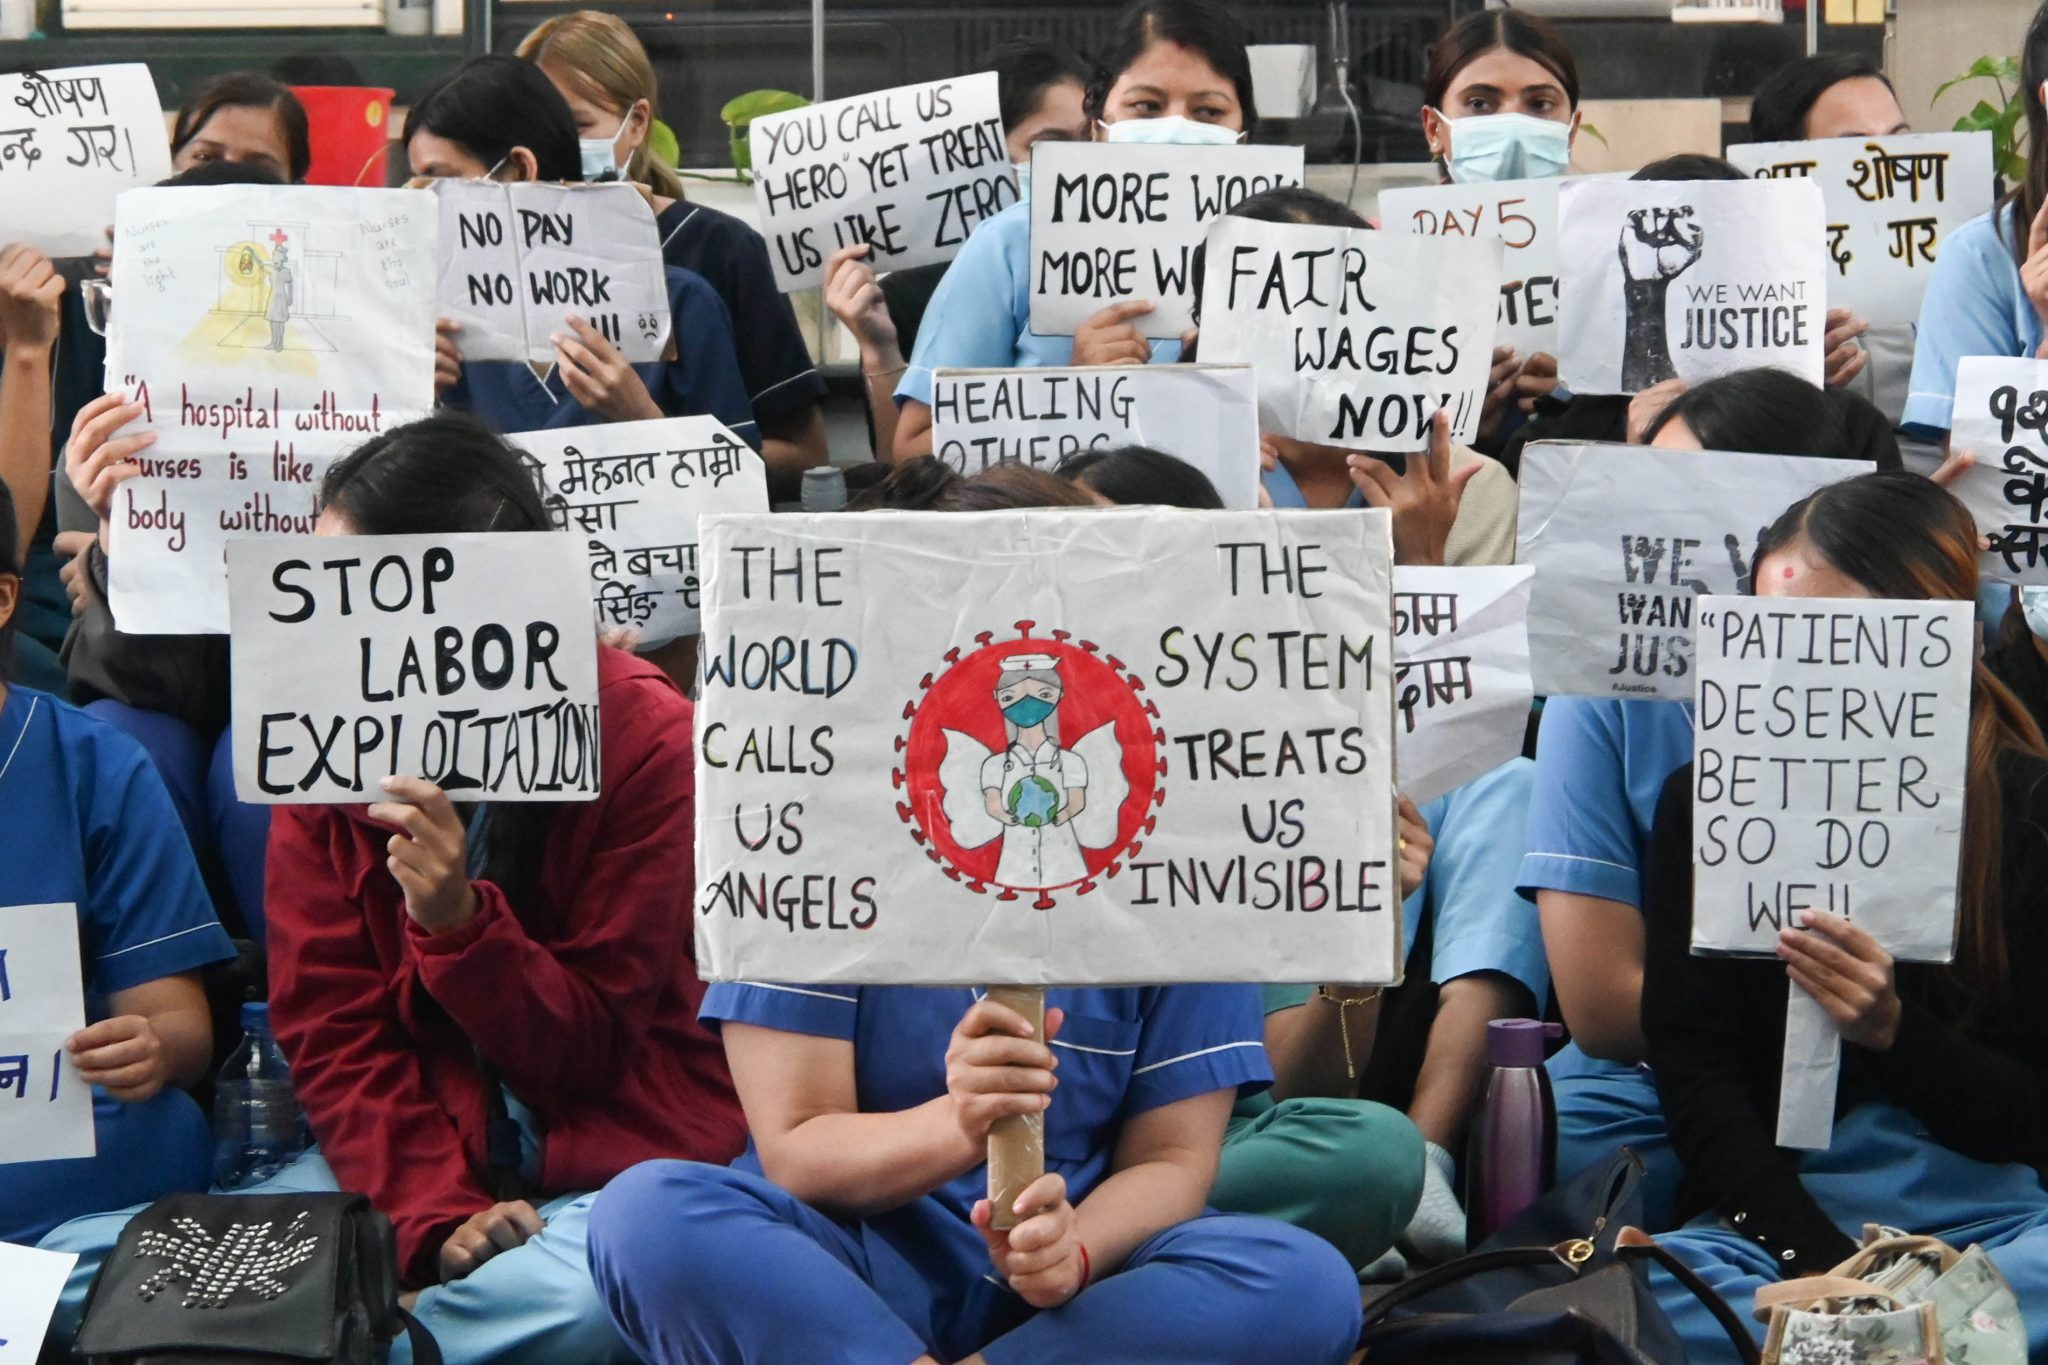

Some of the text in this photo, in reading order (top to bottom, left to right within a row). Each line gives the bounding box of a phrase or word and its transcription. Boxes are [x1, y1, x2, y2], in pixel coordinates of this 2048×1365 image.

[762, 84, 953, 165] YOU CALL US
[858, 143, 910, 193] YET
[919, 118, 1005, 175] TREAT
[1846, 142, 1949, 203] शोषण
[1051, 172, 1170, 224] MORE
[1412, 198, 1536, 248] DAY 5
[459, 209, 572, 248] NO PAY
[776, 226, 823, 276] US
[468, 267, 611, 307] NO WORK
[1037, 246, 1137, 298] MORE
[1228, 245, 1377, 316] FAIR
[1686, 281, 1806, 304] WE WANT
[1295, 326, 1459, 376] WAGES
[1680, 304, 1809, 350] JUSTICE
[182, 383, 278, 439] hospital
[295, 390, 381, 432] without
[934, 375, 1136, 429] HEALING
[229, 452, 247, 480] is
[273, 441, 313, 483] like
[558, 445, 661, 495] मेहनत
[666, 432, 746, 489] हाम्रो
[128, 489, 320, 552] body without
[268, 546, 455, 624] STOP
[588, 540, 699, 582] ले बचा
[730, 546, 844, 607] THE
[1215, 541, 1329, 599] THE
[1621, 534, 1701, 586] WE
[1617, 592, 1692, 629] WAN
[359, 620, 569, 702] LABOR
[702, 632, 857, 698] WORLD
[1155, 625, 1374, 692] SYSTEM
[1608, 633, 1691, 677] JUS
[1701, 611, 1951, 668] "PATIENTS
[1612, 682, 1657, 693] #Justice
[1701, 680, 1938, 740] DESERVE
[256, 697, 600, 796] EXPLOITATION
[701, 721, 835, 777] CALLS
[1173, 726, 1368, 781] TREATS
[1698, 748, 1940, 812] BETTER
[734, 800, 805, 856] US
[1241, 798, 1306, 848] US
[1700, 815, 1890, 870] SO DO
[700, 870, 879, 933] ANGELS
[1128, 854, 1387, 913] INVISIBLE
